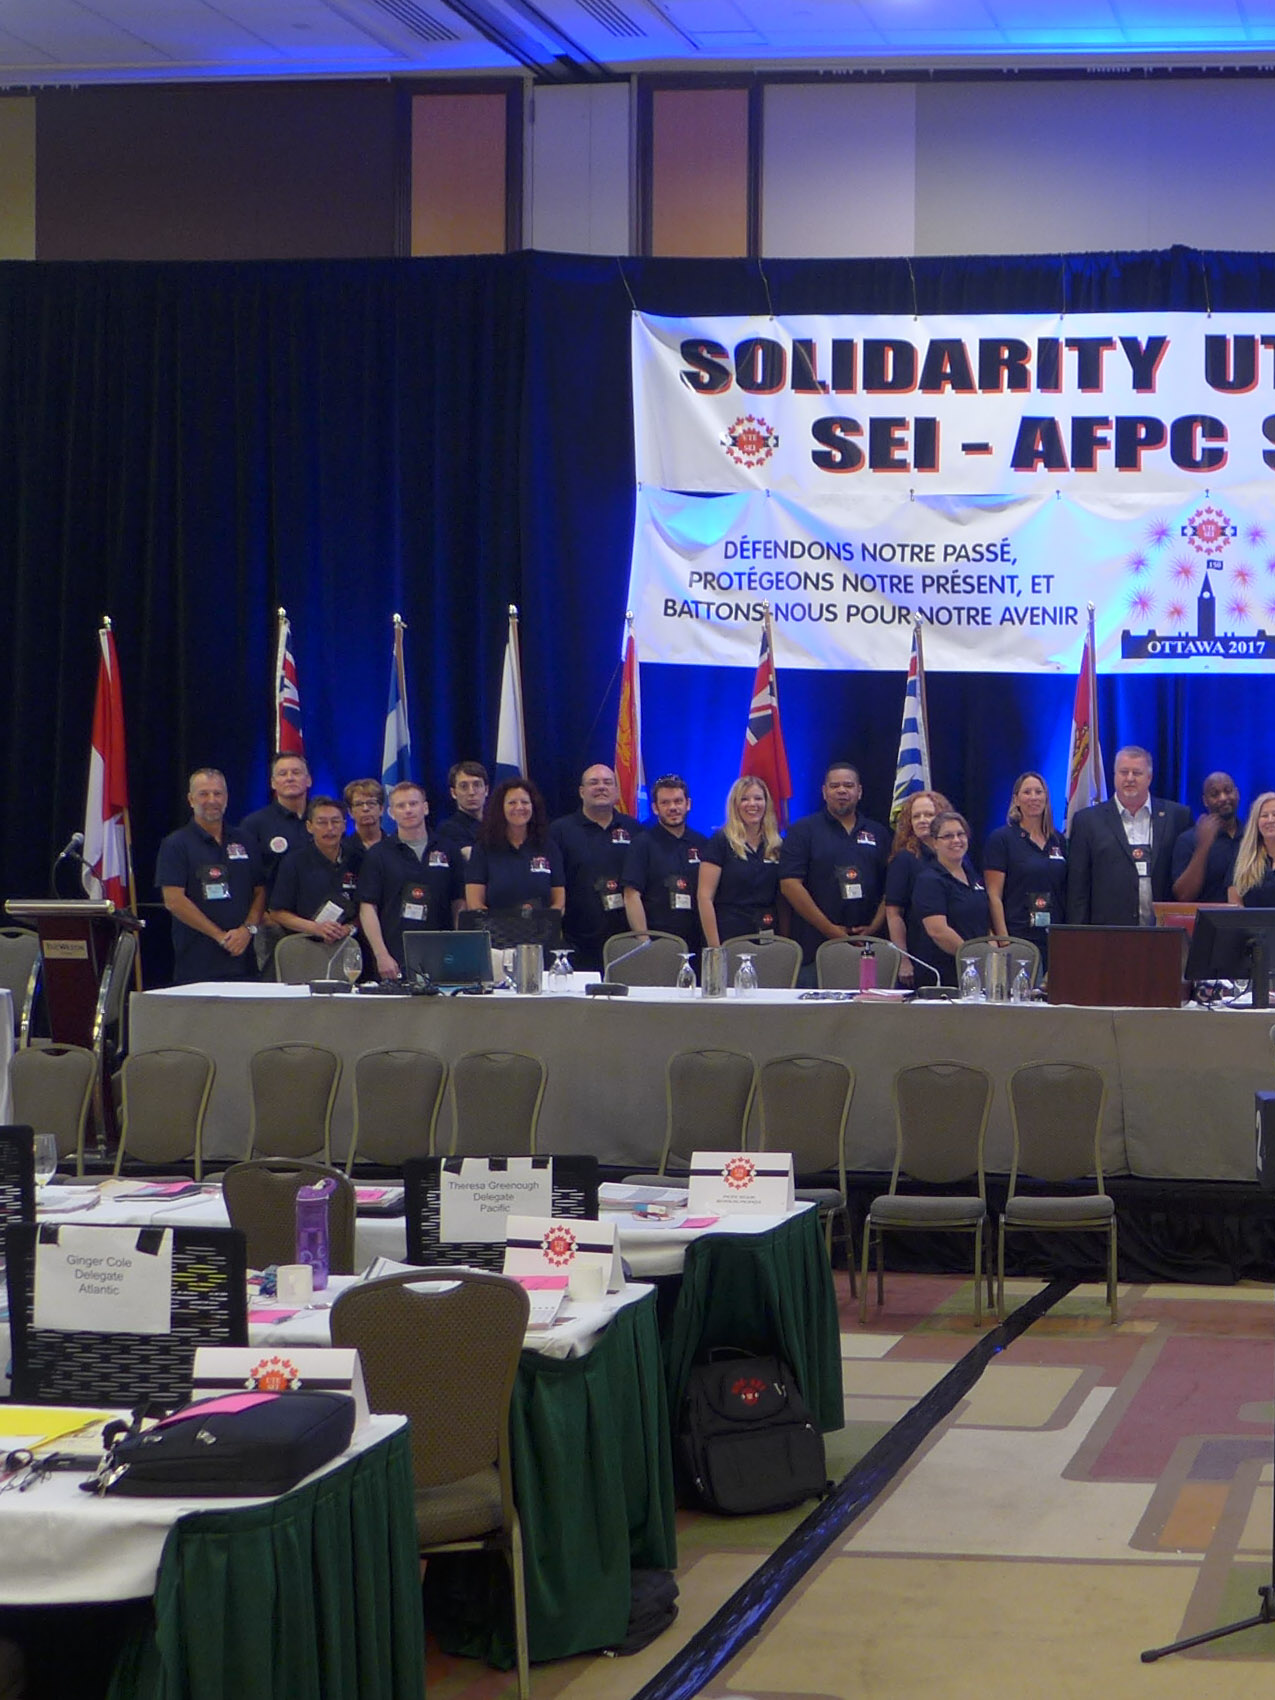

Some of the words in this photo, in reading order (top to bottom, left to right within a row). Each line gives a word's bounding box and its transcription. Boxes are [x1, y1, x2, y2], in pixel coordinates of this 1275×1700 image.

[678, 335, 1171, 394] SOLIDARITY
[811, 416, 940, 473] SEI
[961, 442, 994, 456] -
[1010, 415, 1228, 473] AFPC
[723, 536, 854, 561] DÉFENDONS
[861, 542, 936, 563] NOTRE
[943, 537, 1018, 567] PASSÉ,
[688, 566, 834, 592] PROTÉGEONS
[842, 573, 914, 595] NOTRE
[922, 570, 1022, 598] PRÉSENT,
[1031, 574, 1054, 595] ET
[846, 604, 911, 625] POUR
[920, 605, 992, 626] NOTRE
[999, 606, 1078, 626] AVENIR
[1147, 641, 1225, 654] OTTAWA
[1228, 641, 1266, 654] 2017
[448, 1181, 486, 1190] Theresa
[488, 1181, 539, 1191] Greenough
[473, 1192, 514, 1202] Delegate
[480, 1203, 511, 1213] Pacific
[66, 1254, 104, 1268] Ginger
[106, 1256, 133, 1268] Cole
[74, 1268, 124, 1283] Delegate
[78, 1283, 120, 1296] Atlantic
